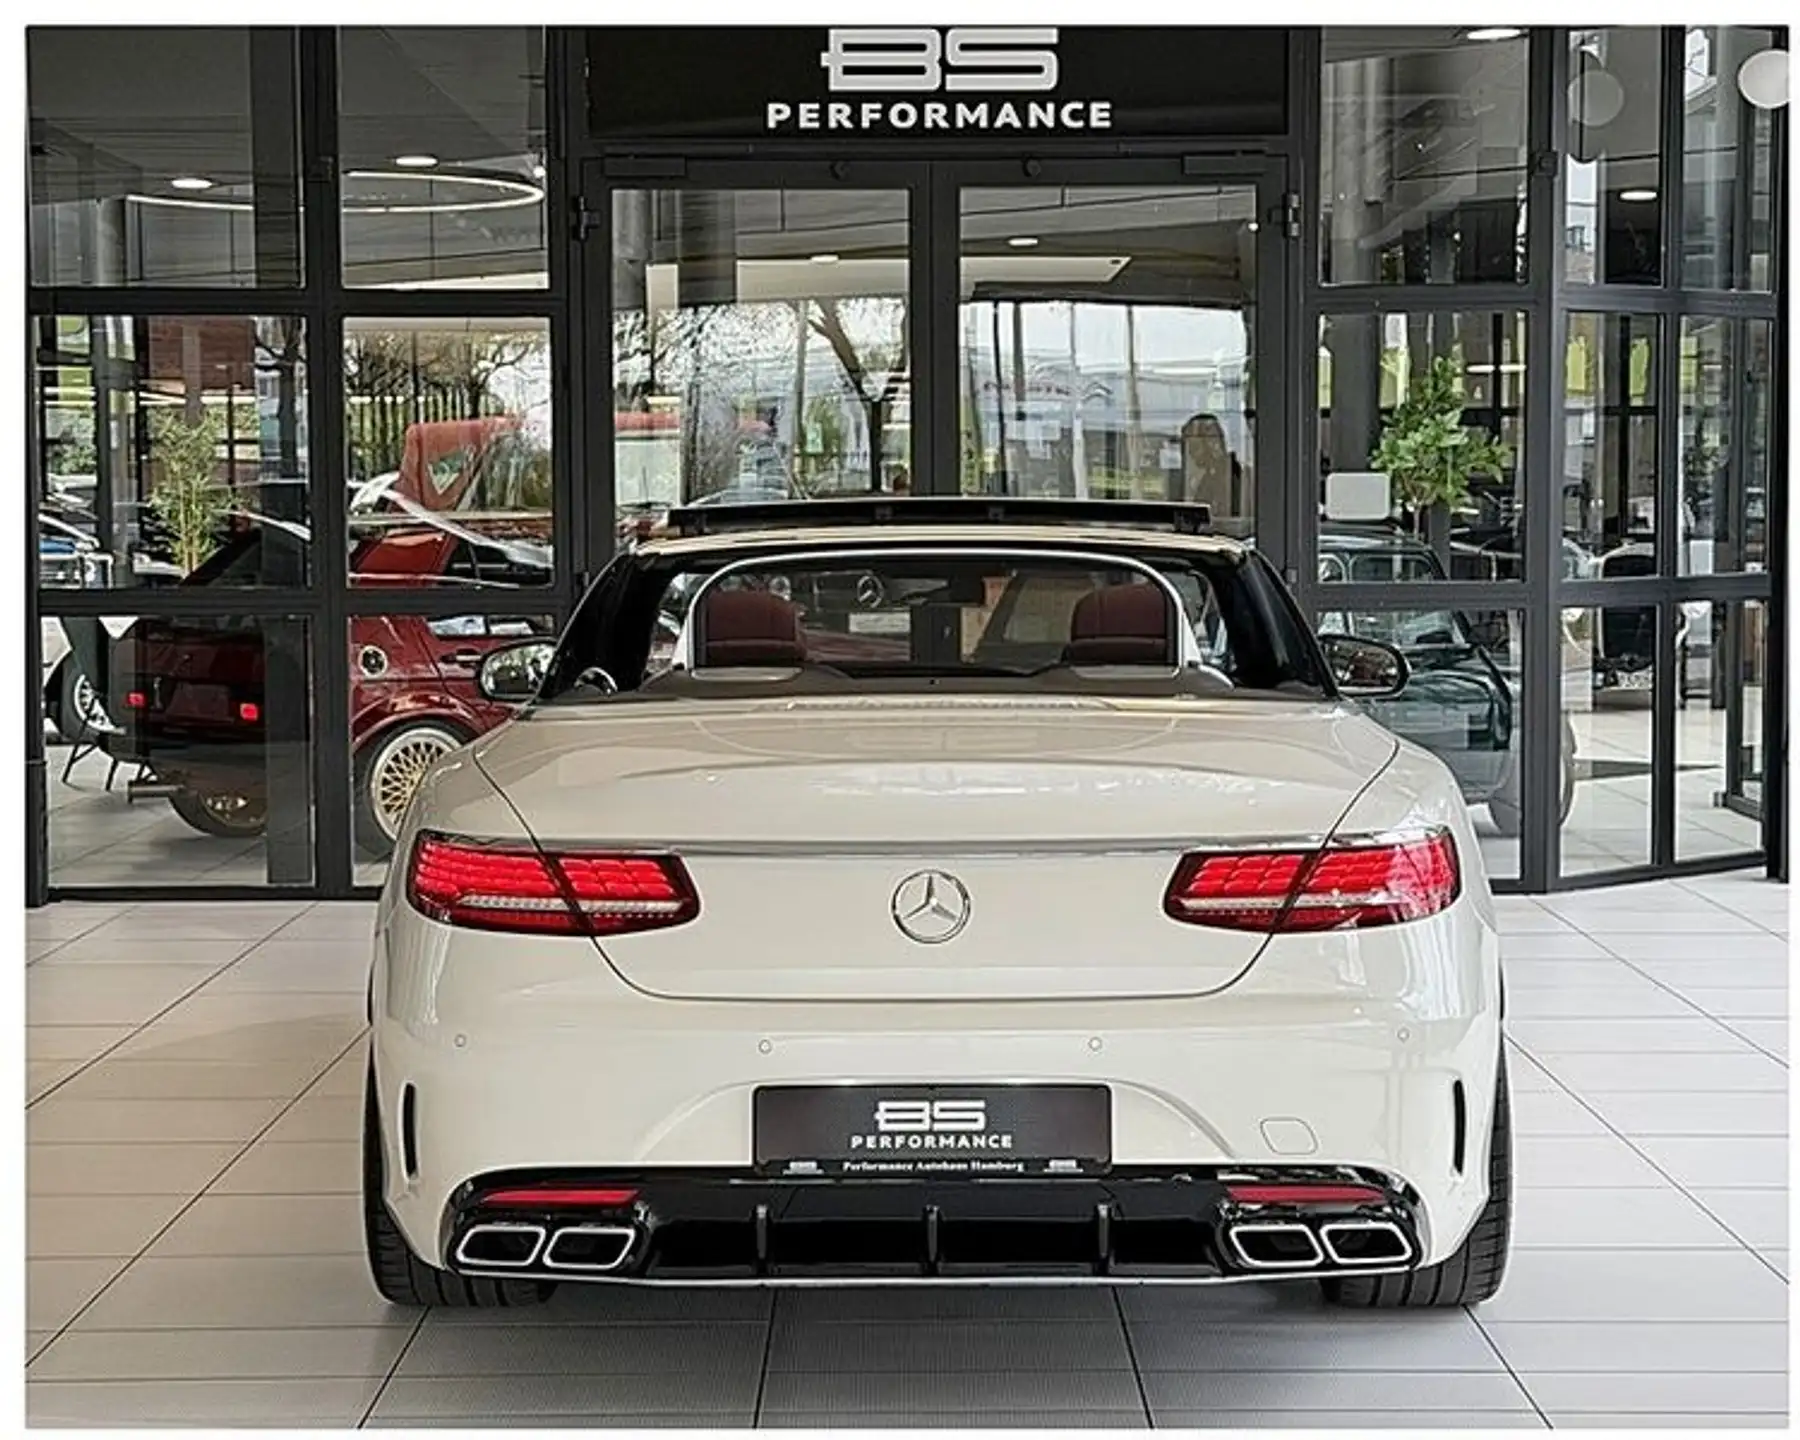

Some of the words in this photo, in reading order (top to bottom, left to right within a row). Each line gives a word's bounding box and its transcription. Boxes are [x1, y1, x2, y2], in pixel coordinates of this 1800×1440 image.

[820, 28, 1059, 91] BS
[766, 102, 1112, 129] PERFORMANCE
[874, 1100, 986, 1131] BS
[851, 1135, 1013, 1149] PERFORMANCE
